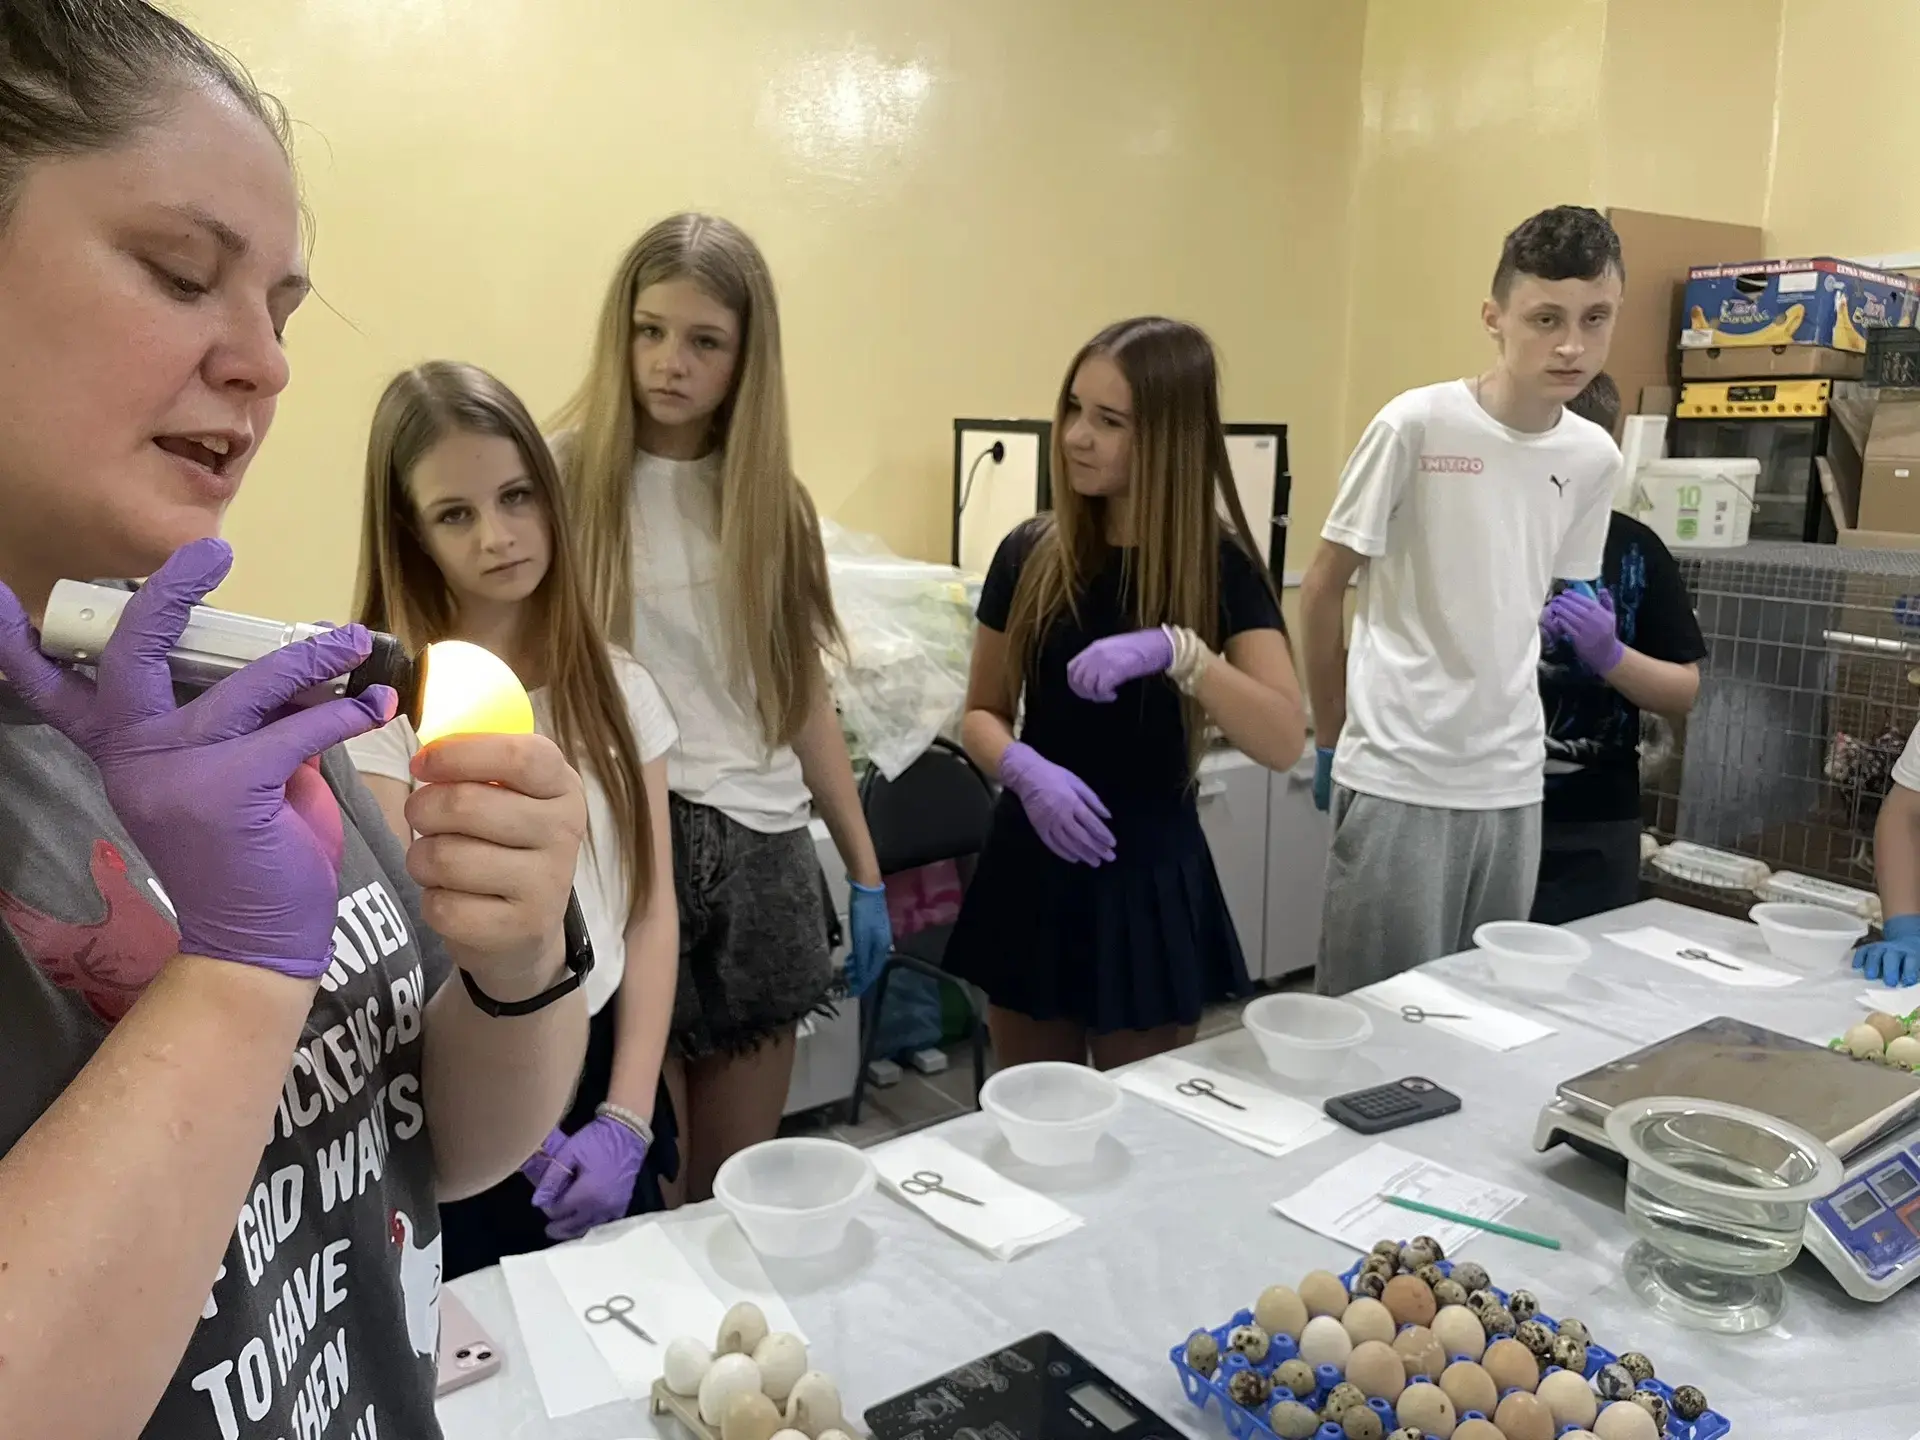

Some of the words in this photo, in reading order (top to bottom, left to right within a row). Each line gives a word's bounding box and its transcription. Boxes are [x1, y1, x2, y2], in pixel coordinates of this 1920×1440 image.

[1677, 485, 1702, 508] 10
[238, 1164, 304, 1287] GOD
[191, 1337, 272, 1440] TO
[269, 1238, 351, 1387] HAVE
